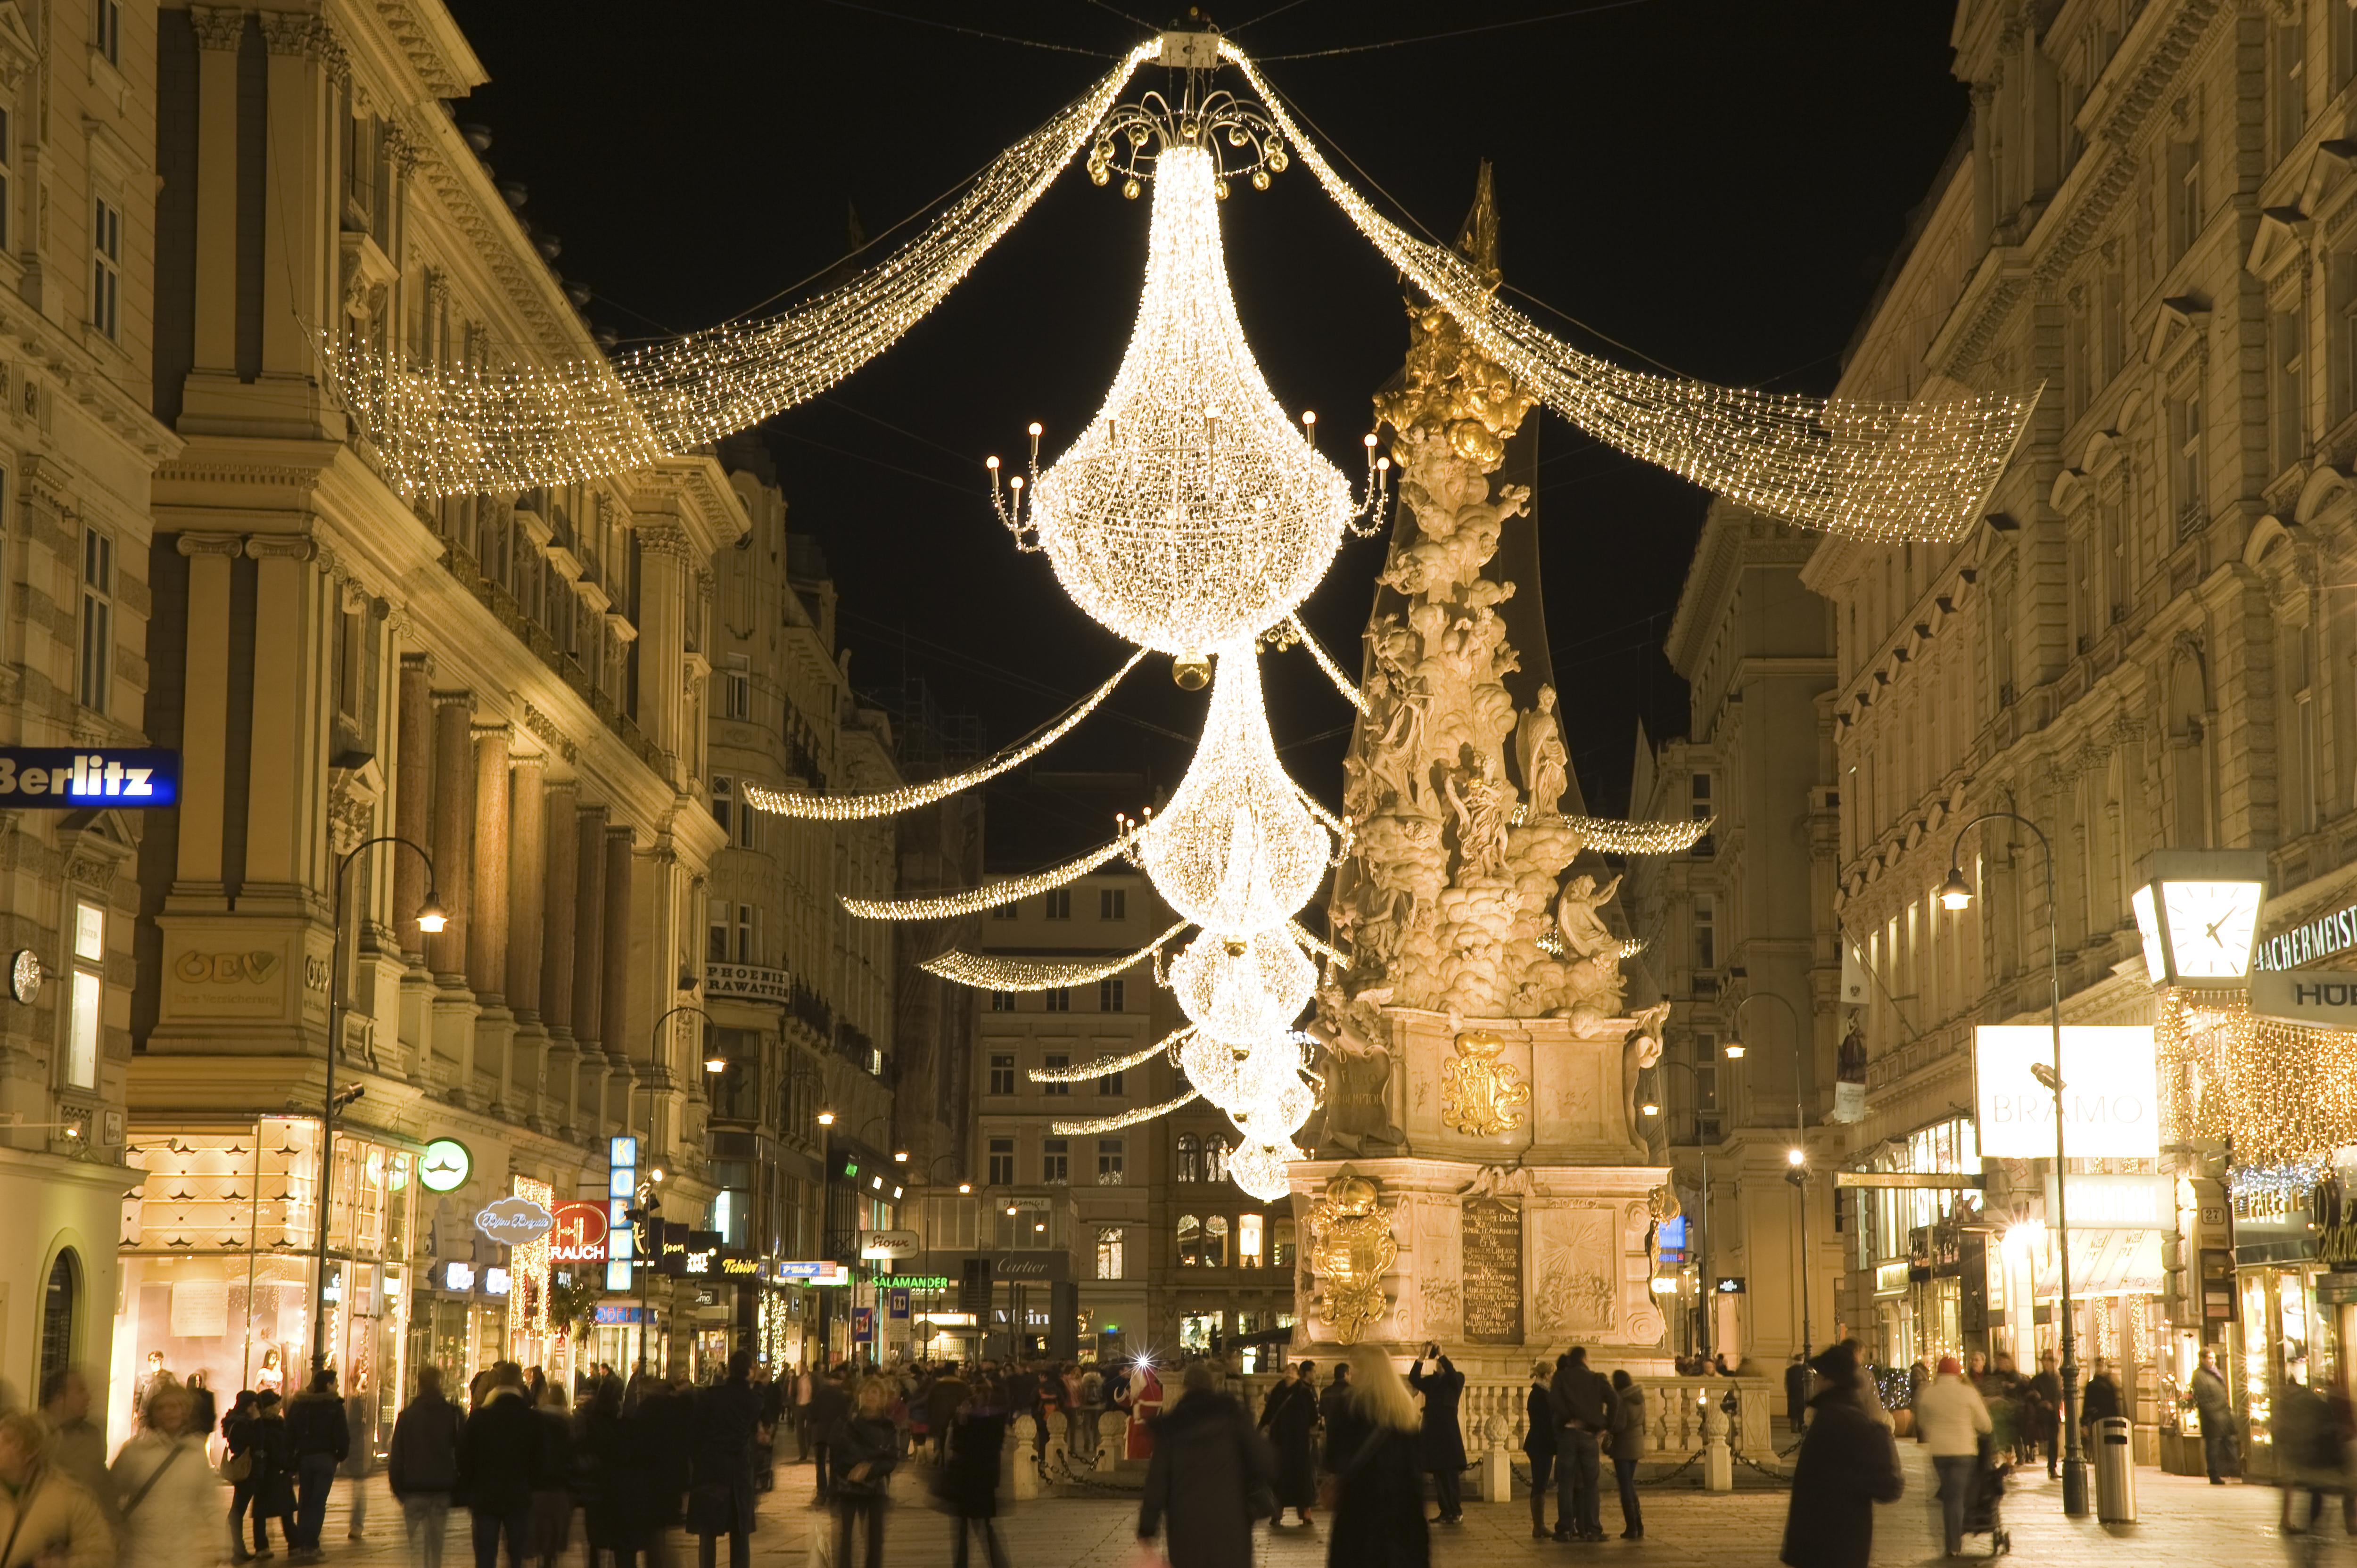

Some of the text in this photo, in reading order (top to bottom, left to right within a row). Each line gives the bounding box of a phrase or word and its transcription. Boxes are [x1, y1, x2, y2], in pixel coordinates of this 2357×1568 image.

[705, 980, 788, 998] RAWATTEN
[1994, 1095, 2142, 1123] BRAMO
[2206, 1210, 2219, 1219] 27
[869, 1235, 909, 1248] Sioux
[550, 1246, 605, 1260] RAUCH
[722, 1259, 758, 1273] Tchibo
[997, 1257, 1048, 1273] Cartier
[872, 1276, 948, 1288] SALAMANDER
[996, 1309, 1049, 1325] Min
